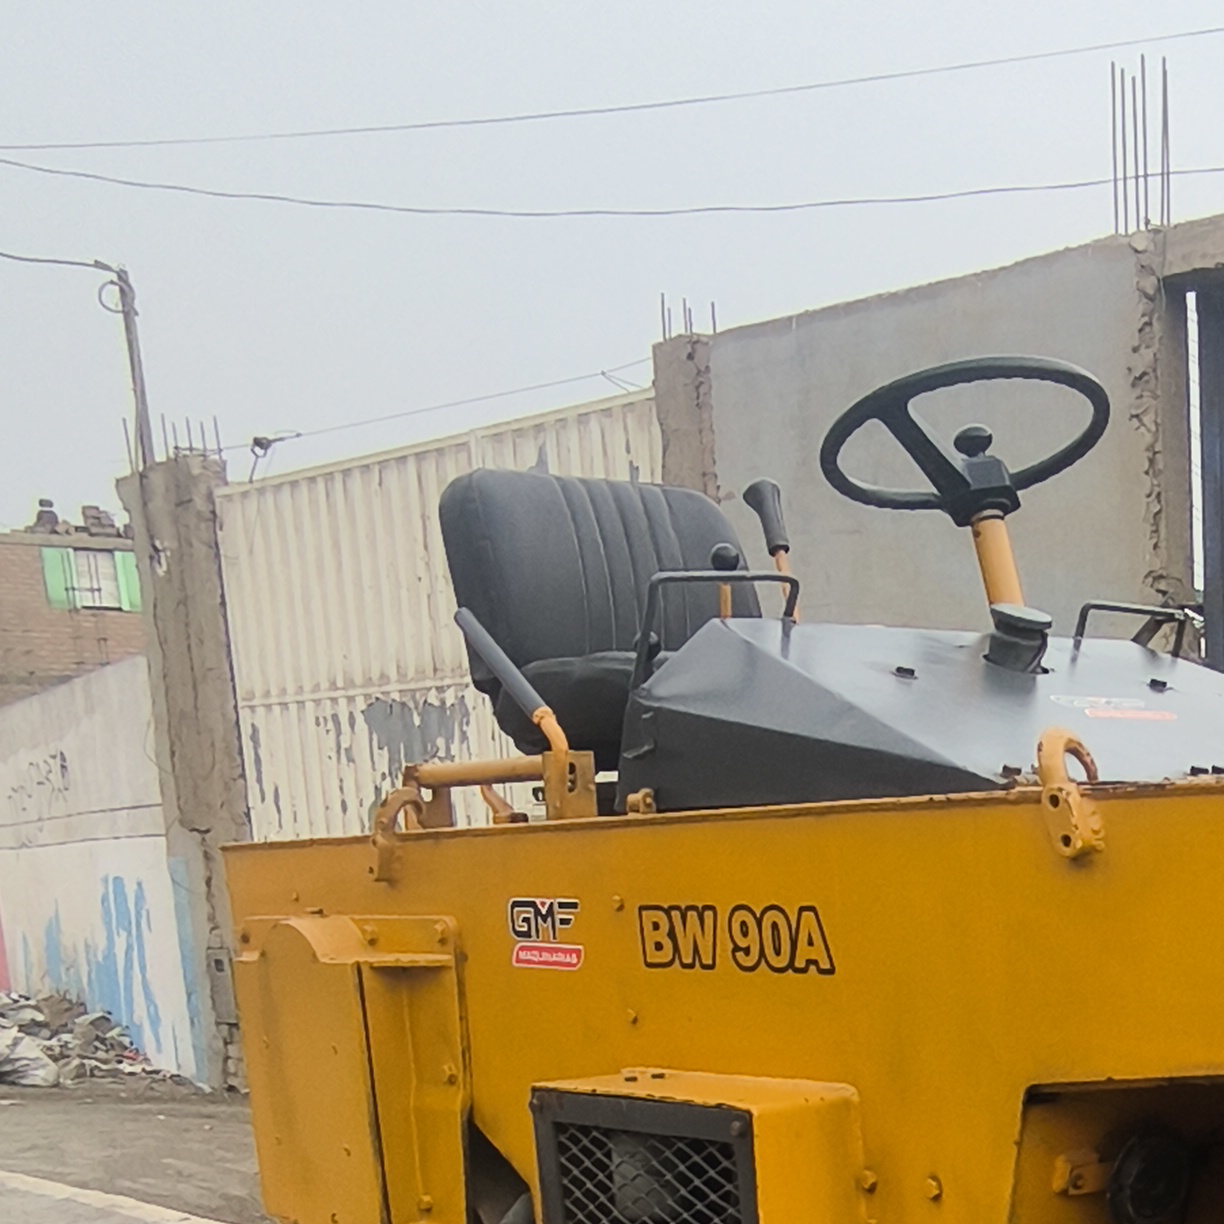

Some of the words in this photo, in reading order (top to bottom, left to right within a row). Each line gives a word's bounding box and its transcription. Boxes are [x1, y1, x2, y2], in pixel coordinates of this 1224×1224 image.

[509, 899, 580, 941] GMF
[638, 904, 716, 970] BW
[728, 904, 836, 975] 90A
